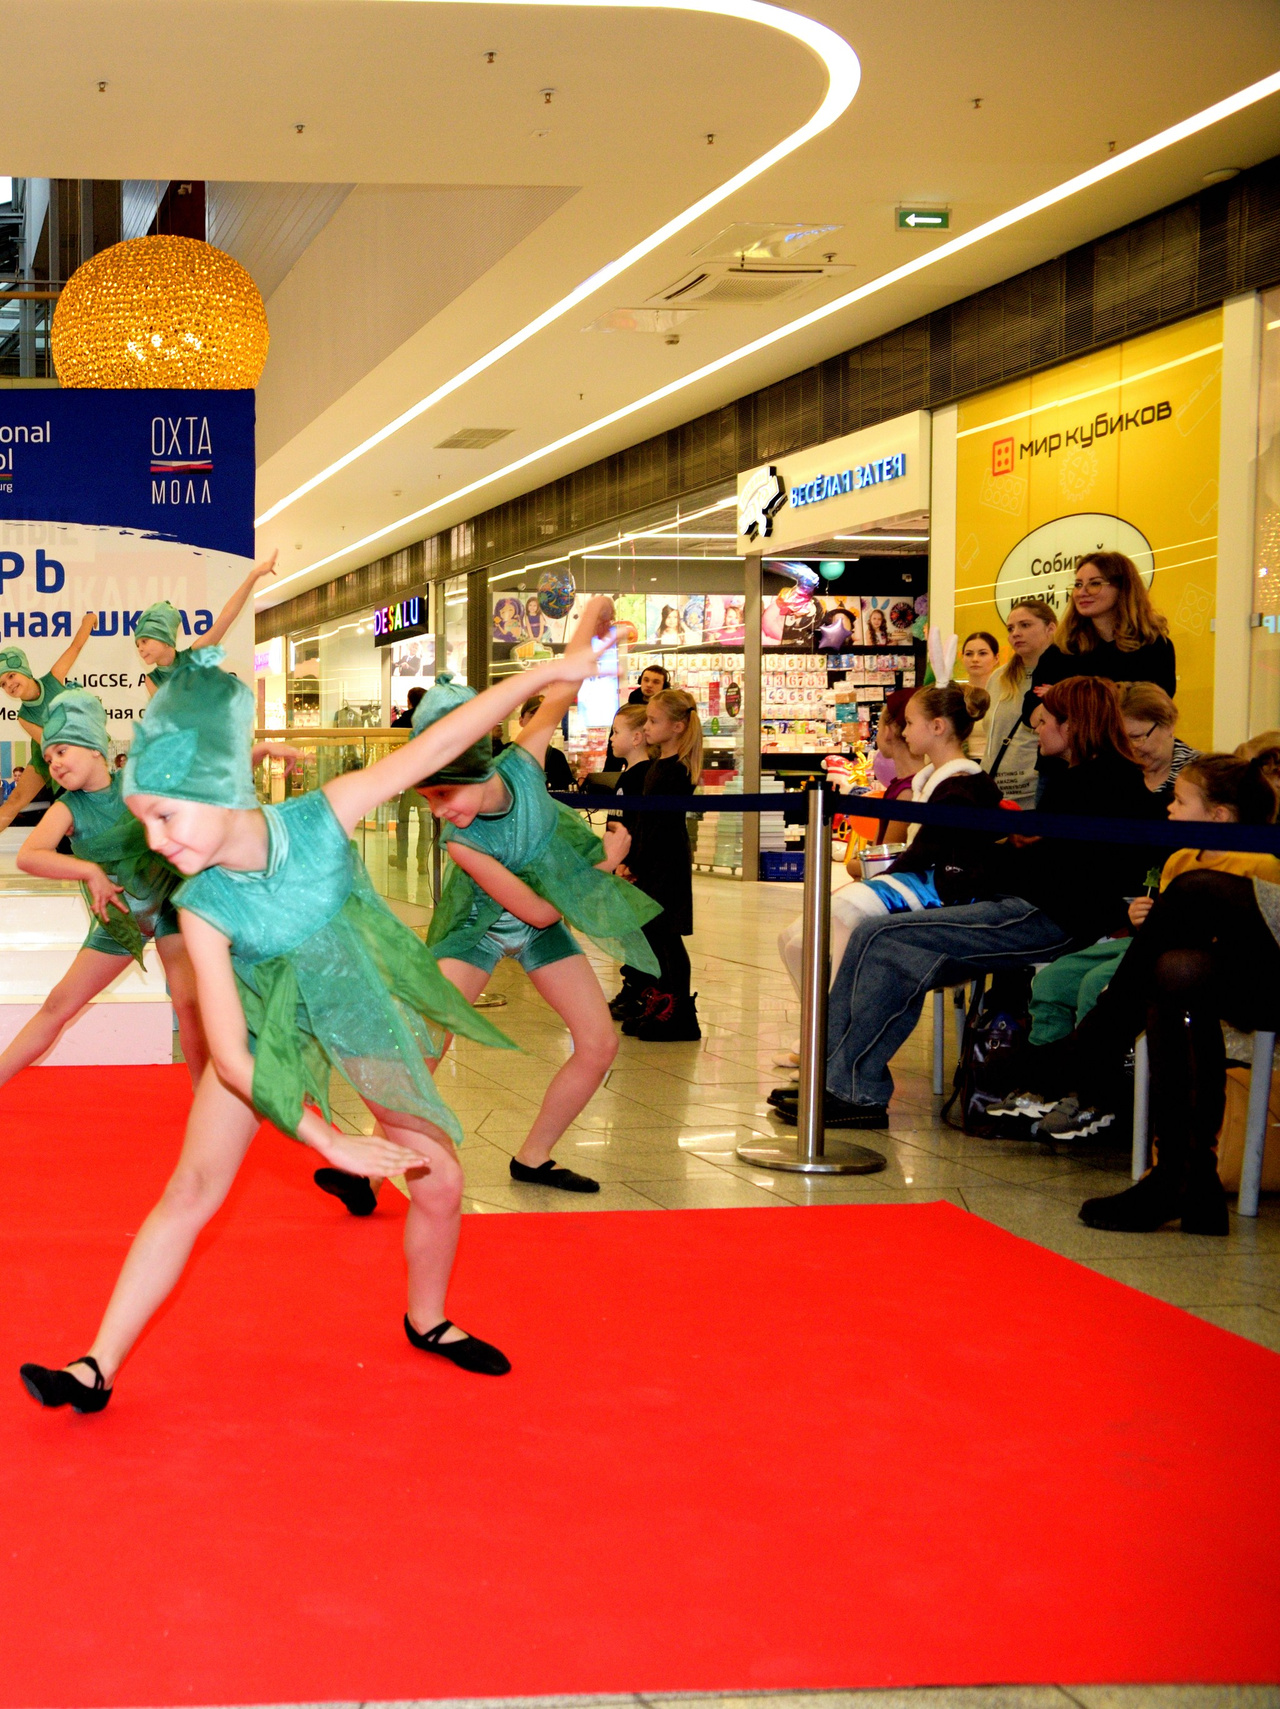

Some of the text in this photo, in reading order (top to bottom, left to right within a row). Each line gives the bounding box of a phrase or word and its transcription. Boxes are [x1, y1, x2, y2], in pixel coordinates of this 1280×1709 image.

[151, 416, 212, 456] ОХТА
[1065, 400, 1173, 449] кубиков
[790, 452, 907, 508] ВЕСЁЛАЯ ЗАТЕЯ
[87, 608, 214, 637] шкла
[373, 596, 420, 637] DESALU
[83, 674, 133, 689] IGCSE,
